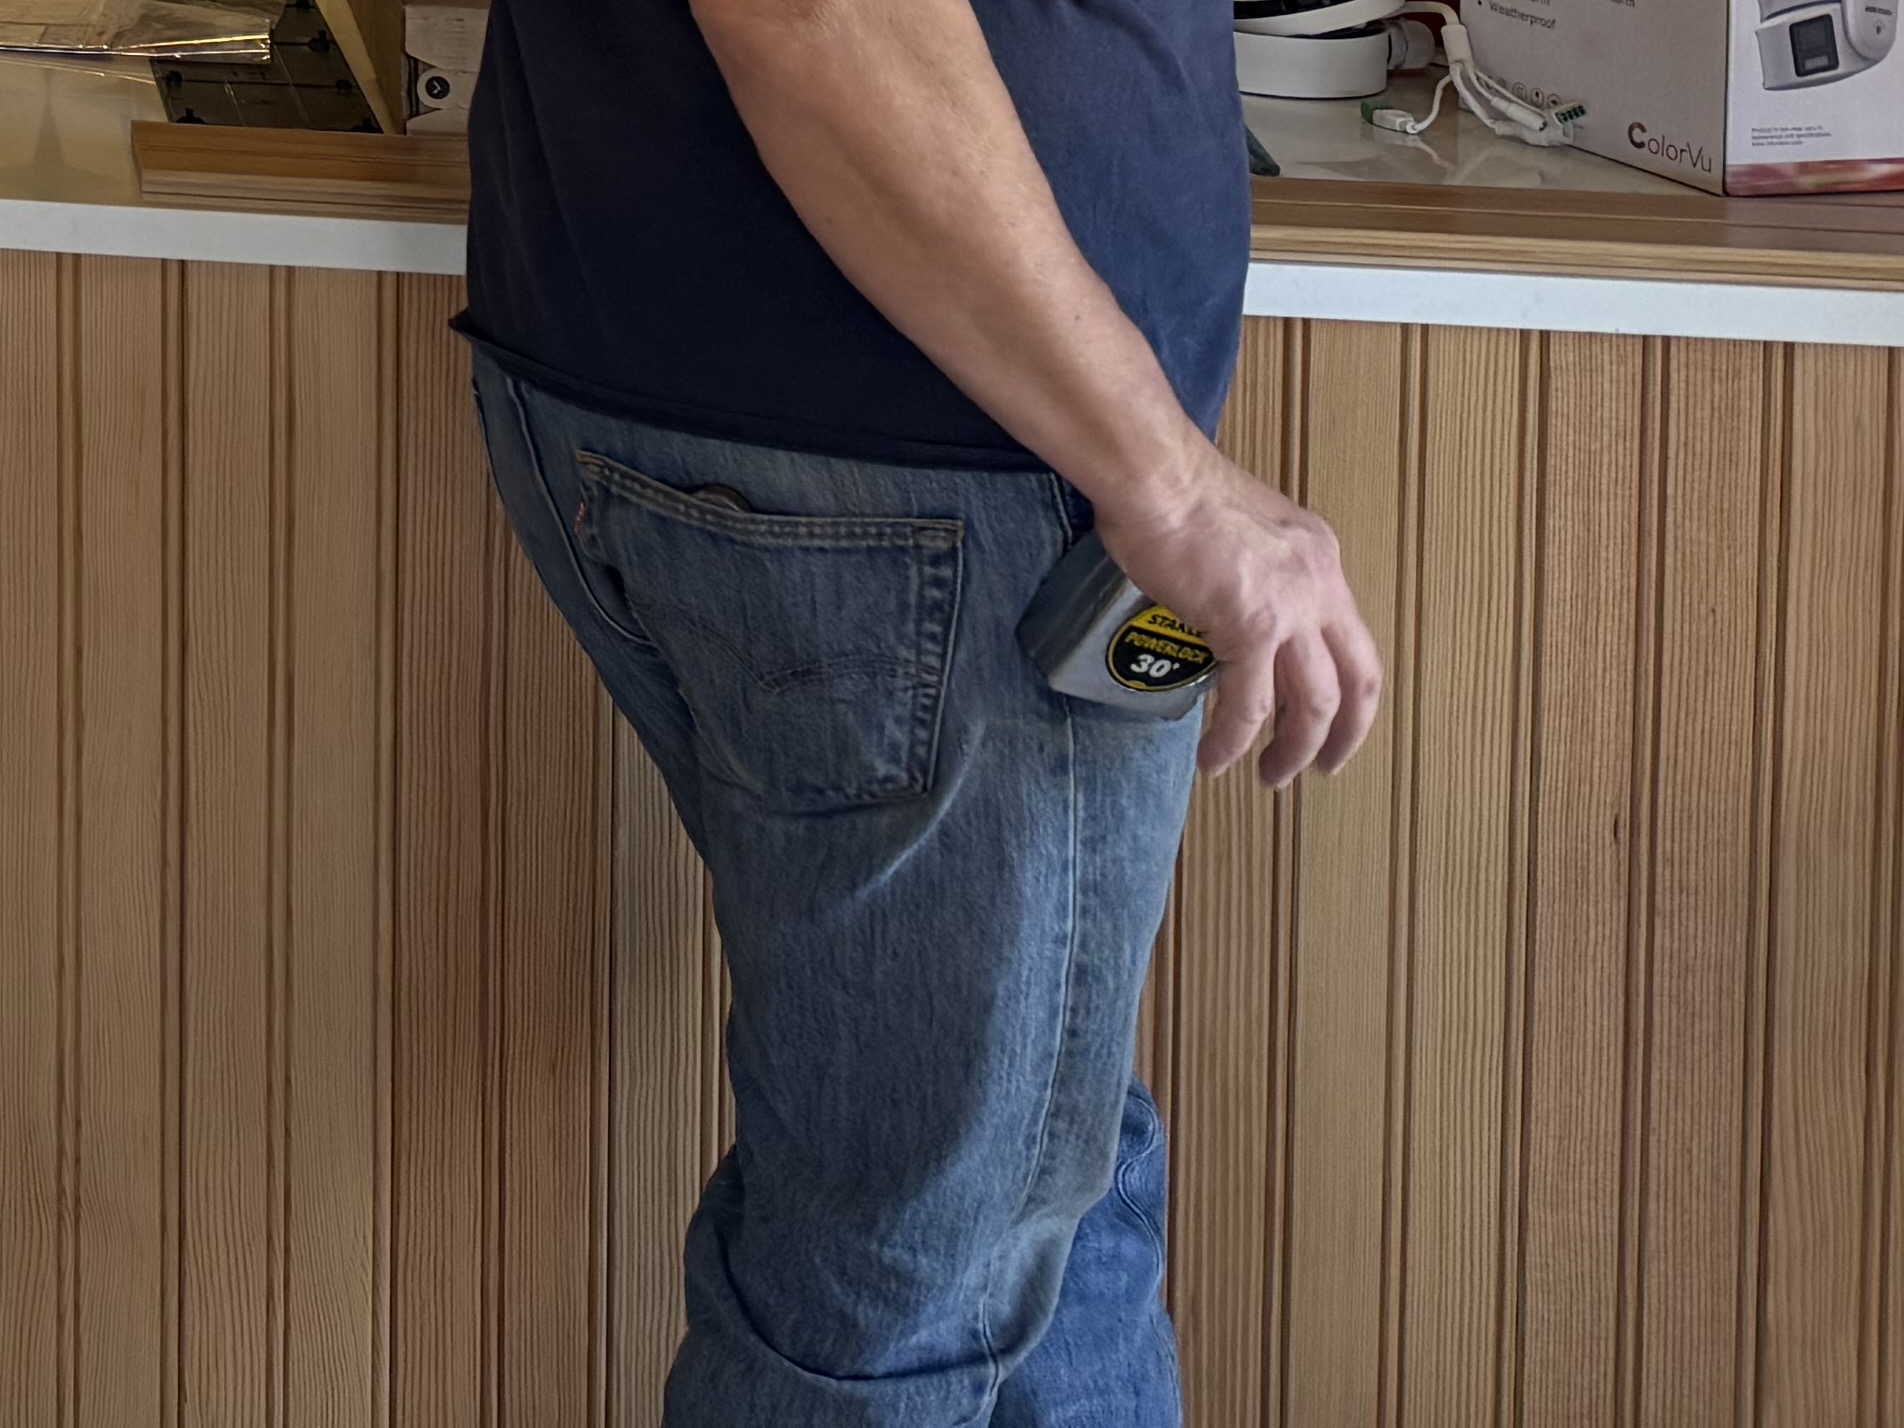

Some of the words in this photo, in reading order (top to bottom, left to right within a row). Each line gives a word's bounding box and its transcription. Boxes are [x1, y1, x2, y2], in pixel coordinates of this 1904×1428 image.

[1488, 0, 1557, 30] Weatherproof
[1627, 121, 1712, 173] ColorVu
[1124, 631, 1208, 664] POWERLOCK
[1130, 653, 1181, 678] 30'
